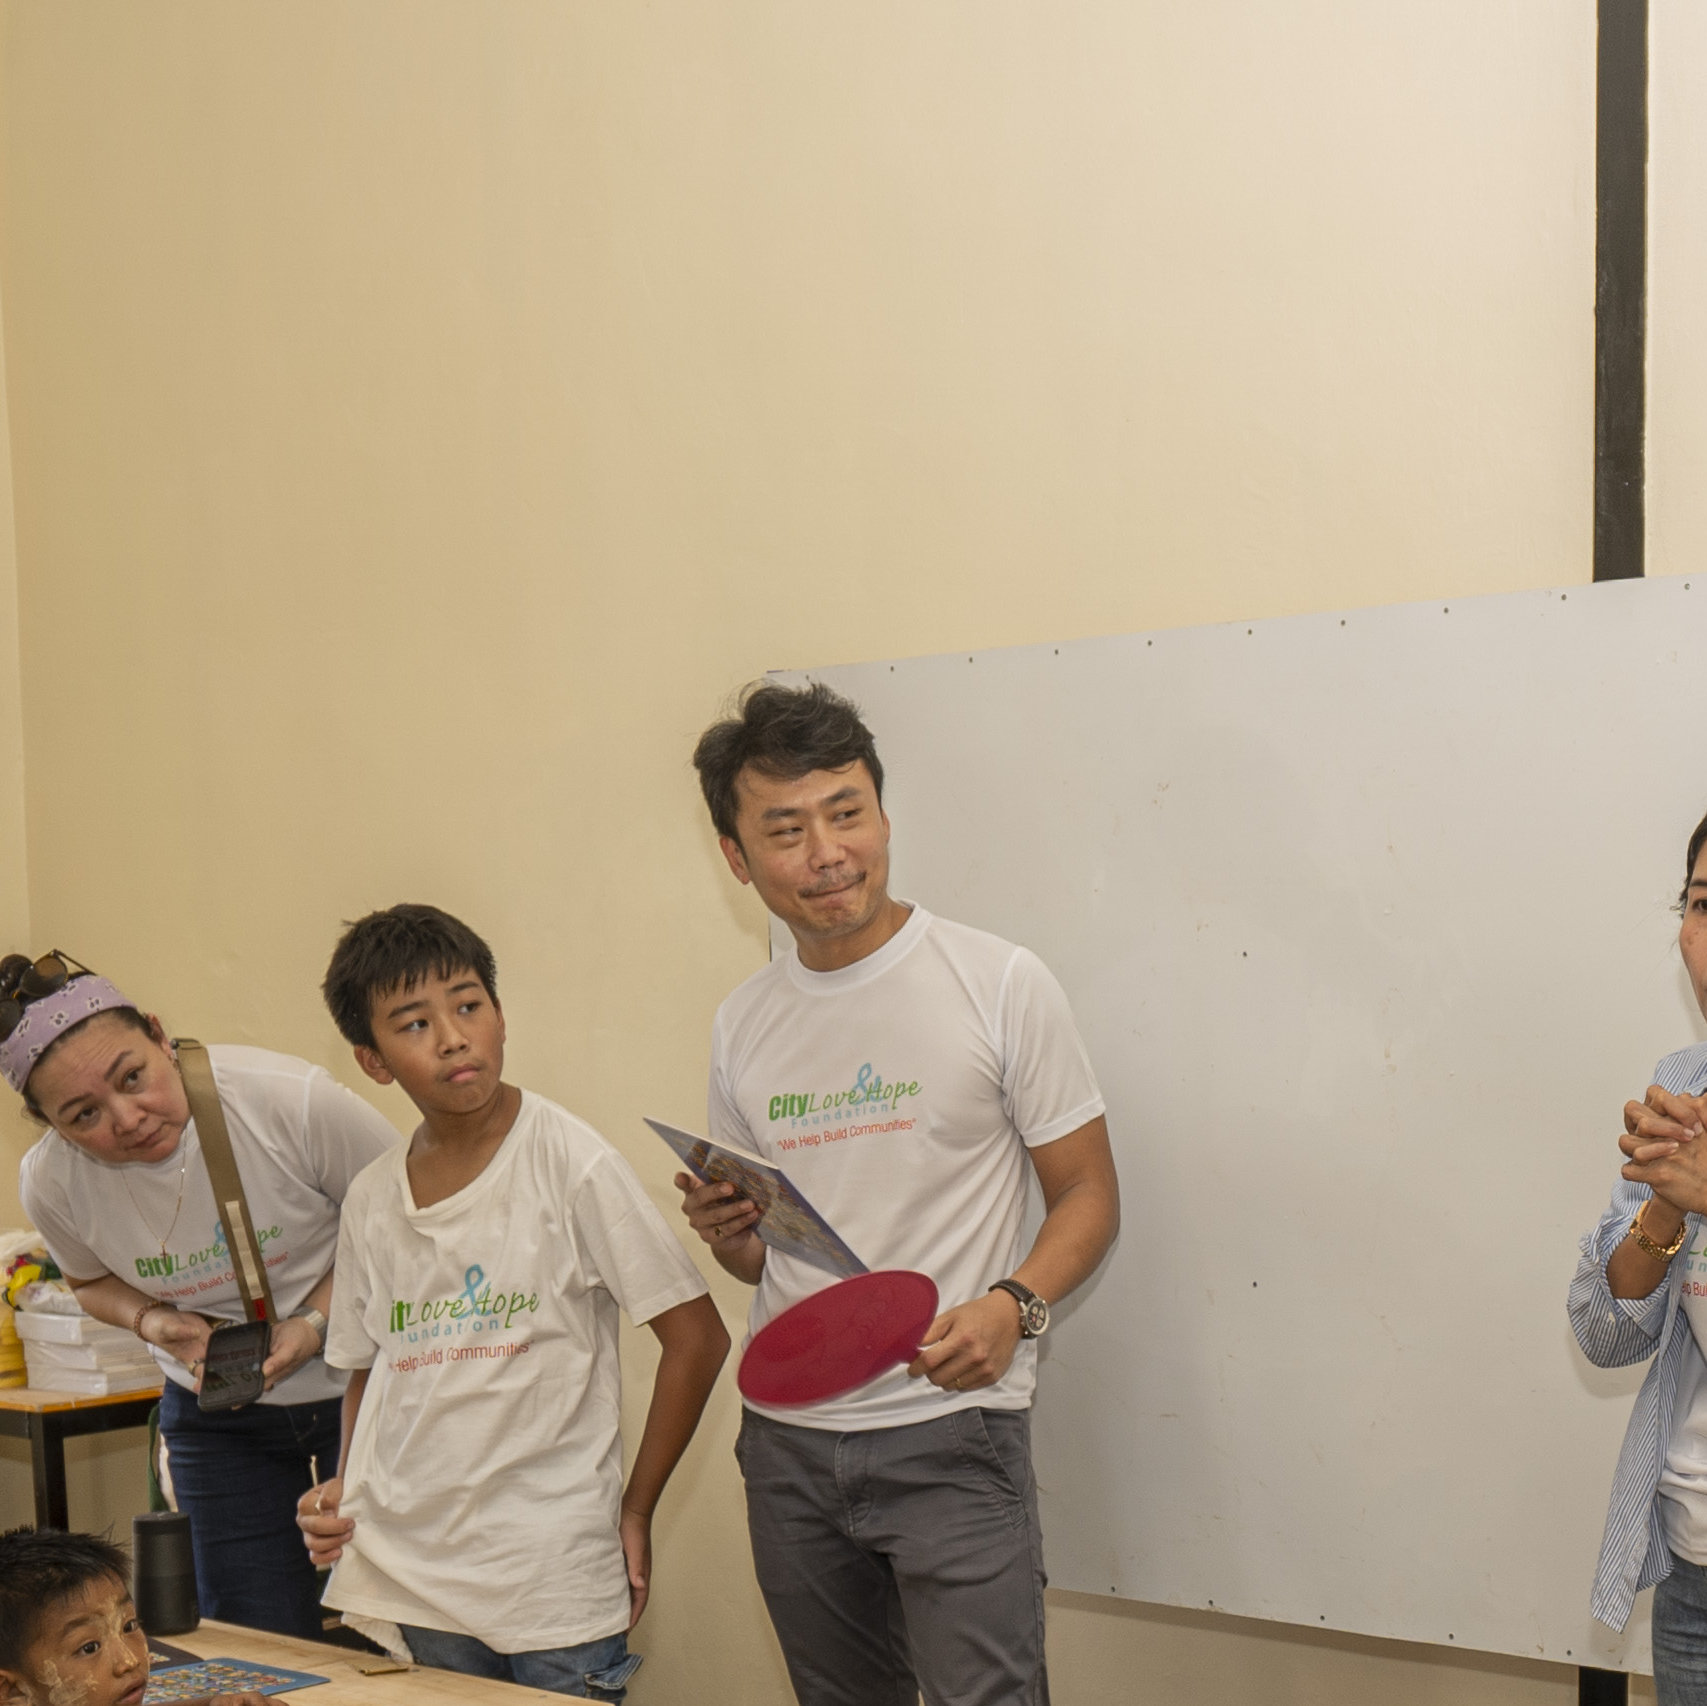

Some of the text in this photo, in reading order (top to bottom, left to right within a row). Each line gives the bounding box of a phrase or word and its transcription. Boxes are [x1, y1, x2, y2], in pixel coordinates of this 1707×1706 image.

[768, 1092, 809, 1121] City
[808, 1089, 860, 1112] Love
[866, 1080, 923, 1110] Hope
[791, 1102, 889, 1129] Foundation
[798, 1133, 821, 1148] Help
[823, 1127, 848, 1143] Build
[135, 1254, 174, 1278] City
[174, 1243, 226, 1271] Love
[256, 1225, 284, 1253] pe
[161, 1257, 230, 1285] Foundat
[198, 1276, 224, 1292] Build
